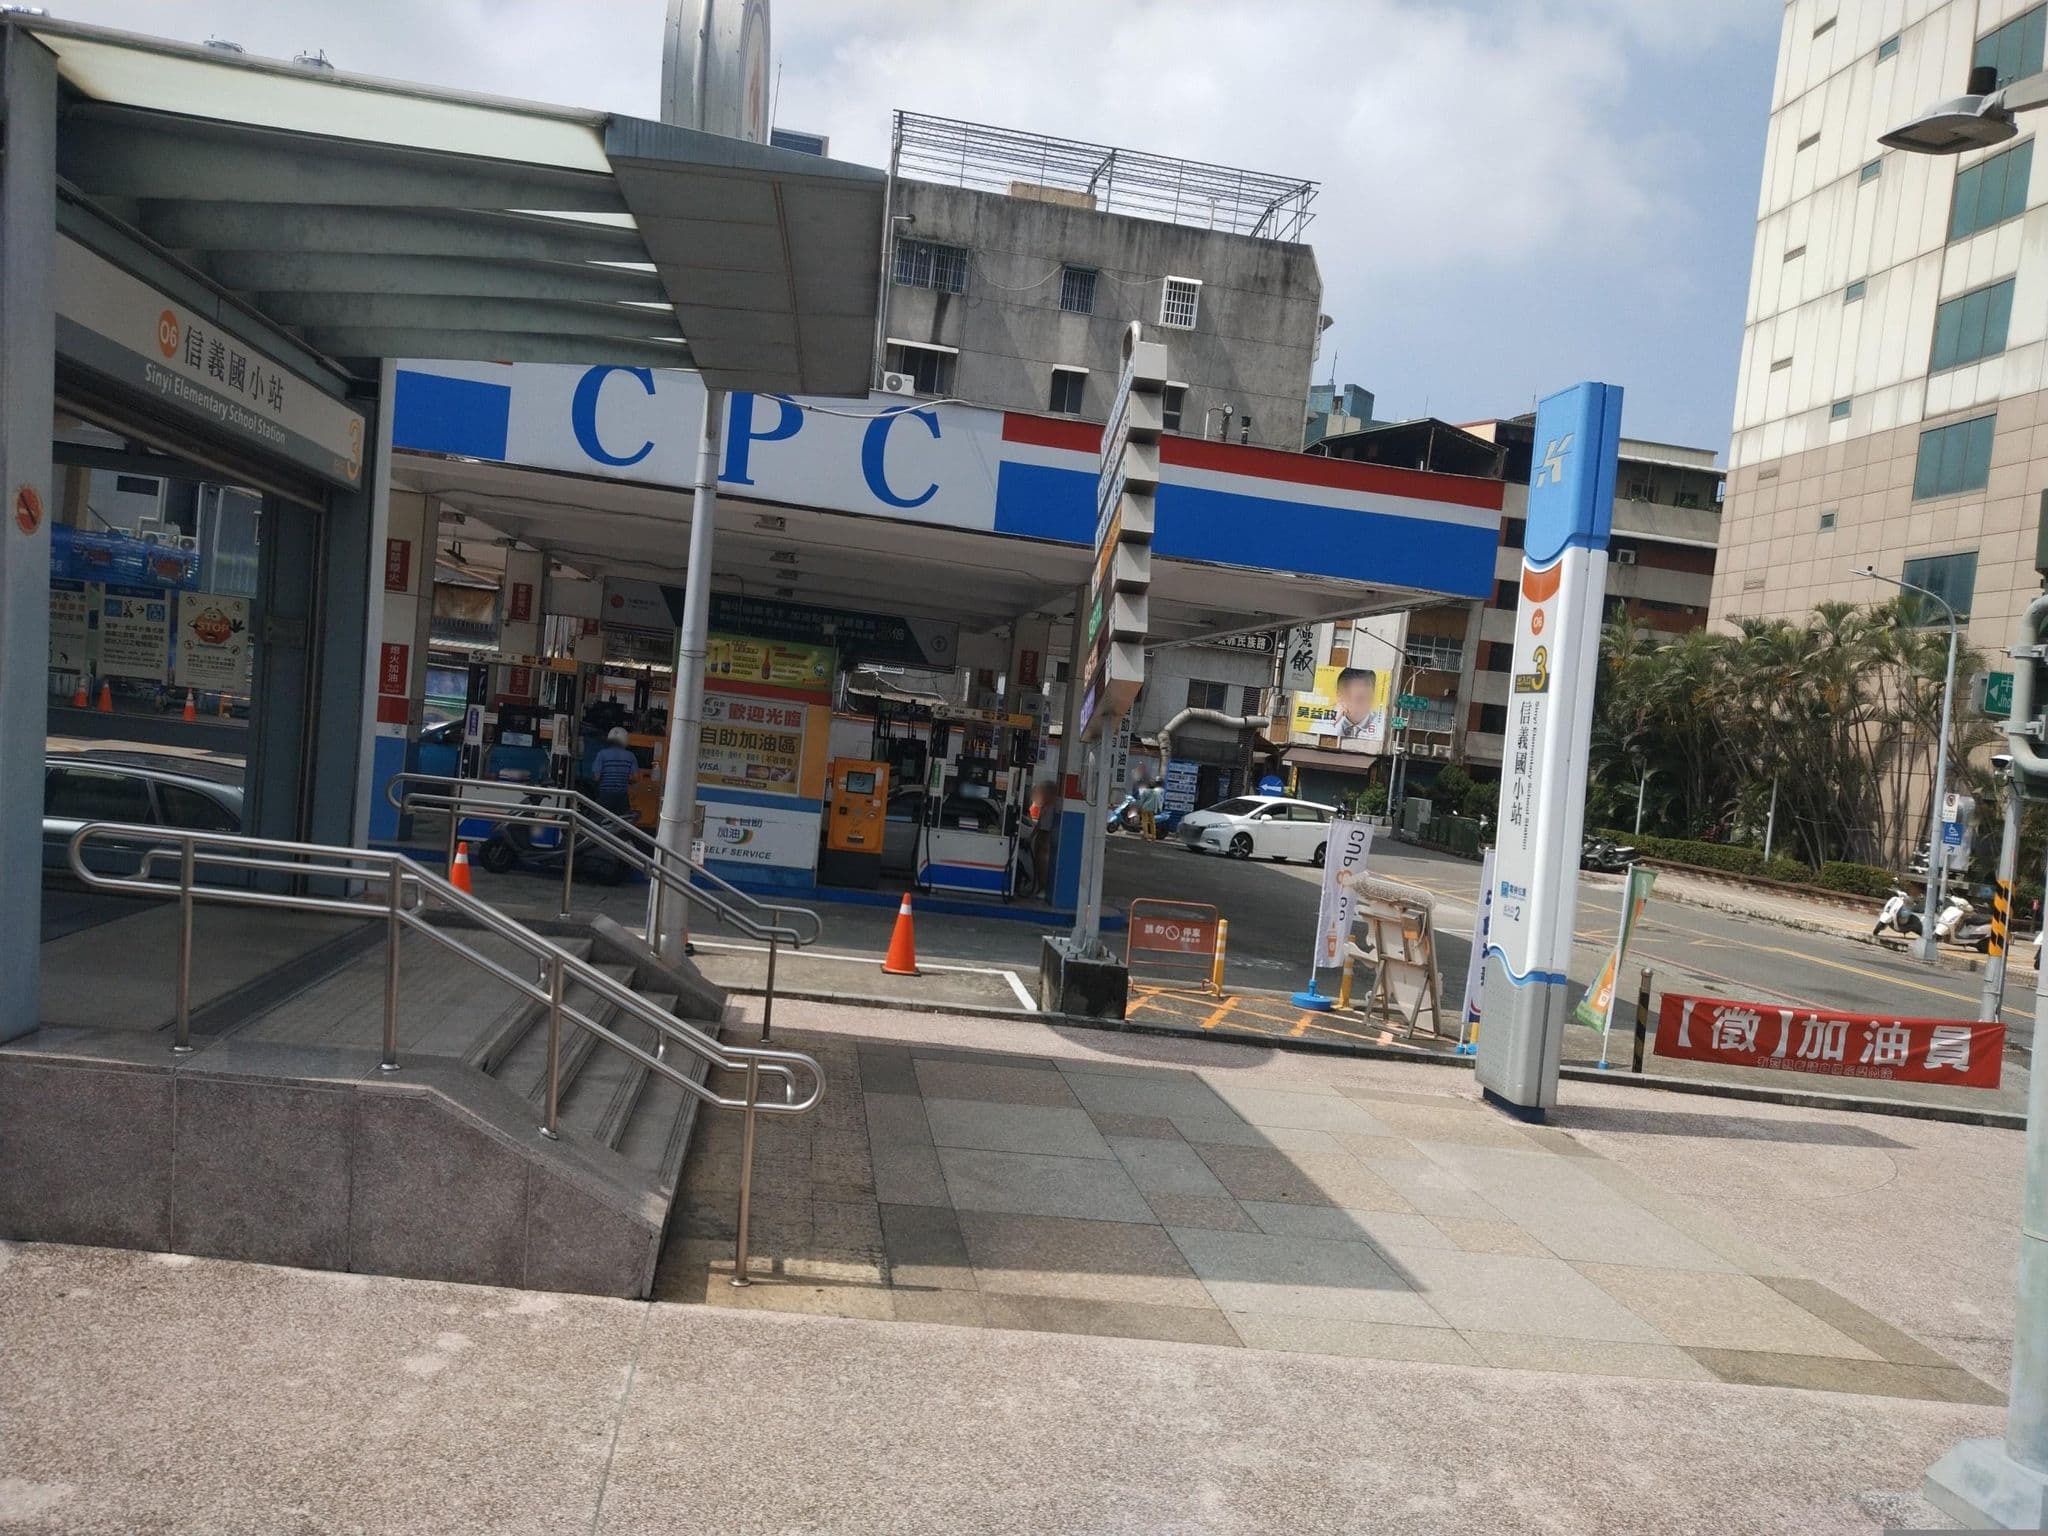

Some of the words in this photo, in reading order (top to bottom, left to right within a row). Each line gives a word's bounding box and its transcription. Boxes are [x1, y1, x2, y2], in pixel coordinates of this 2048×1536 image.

[185, 325, 284, 414] 信義國小站
[145, 363, 173, 394] Sinyi
[174, 376, 229, 421] Elementary
[228, 404, 258, 433] School
[258, 418, 287, 444] Station
[571, 365, 941, 509] CPC
[196, 621, 229, 633] STOP
[1532, 645, 1548, 691] 3
[728, 702, 801, 728] 歡迎光臨
[700, 726, 797, 754] 自助加油區
[698, 761, 719, 772] VISA
[1511, 701, 1532, 826] 信義國小站
[717, 826, 741, 839] 加油
[704, 845, 728, 856] SELF
[730, 848, 773, 861] SERVICE
[1514, 905, 1521, 922] 2
